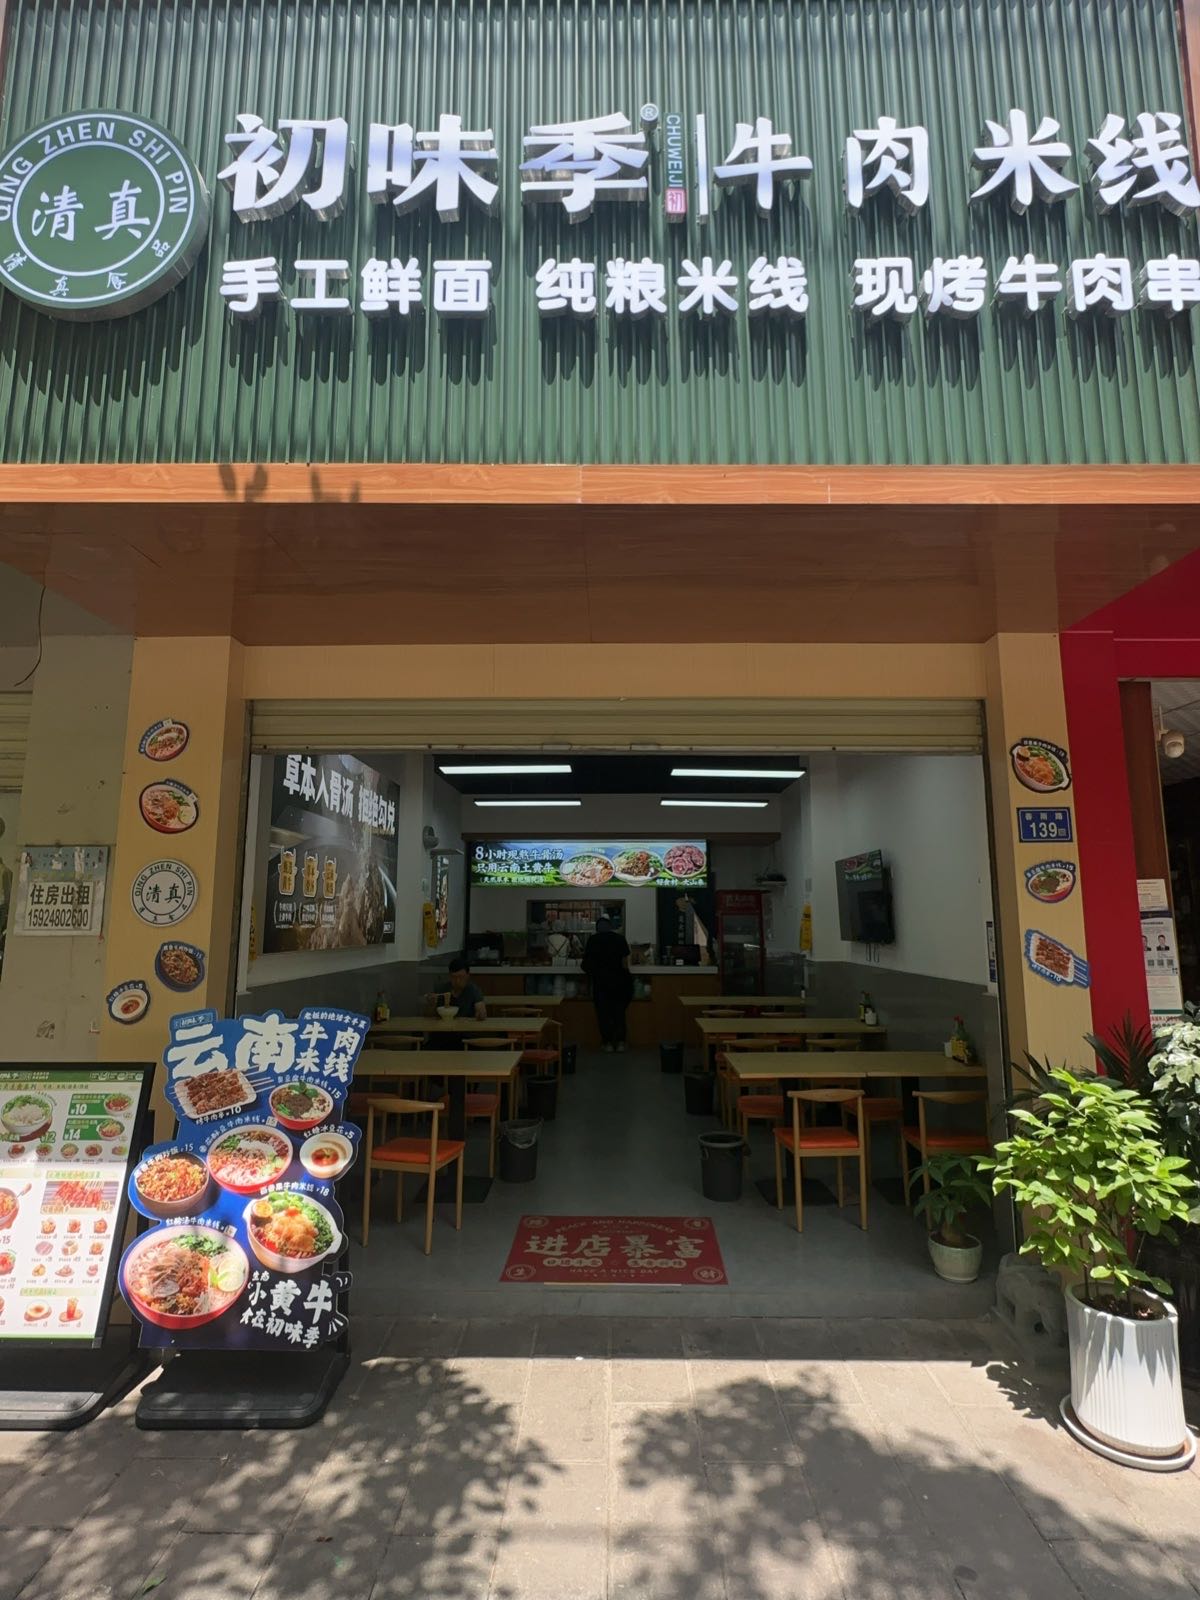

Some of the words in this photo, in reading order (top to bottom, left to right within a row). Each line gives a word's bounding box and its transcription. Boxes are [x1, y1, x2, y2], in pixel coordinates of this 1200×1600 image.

[38, 121, 115, 155] ZHEN
[128, 129, 171, 165] SHI
[165, 170, 188, 214] PIN
[218, 114, 648, 213] 初味季
[714, 108, 1200, 207] 牛肉米线
[666, 114, 683, 187] CHUWEIJI
[32, 180, 151, 241] 清真
[220, 256, 492, 315] 手工鲜面
[536, 256, 808, 315] 纯粮米线
[854, 253, 1200, 317] 现烤牛肉串
[30, 884, 90, 906] 住房出租
[135, 874, 148, 897] QING
[148, 863, 173, 875] ZHEN
[175, 866, 189, 879] SHI
[146, 883, 182, 904] 清真
[168, 1014, 298, 1079] 云南
[299, 1021, 361, 1055] 牛肉
[295, 1048, 353, 1083] 米线
[524, 1234, 706, 1259] 进店暴富
[247, 1278, 333, 1325] 小黄牛
